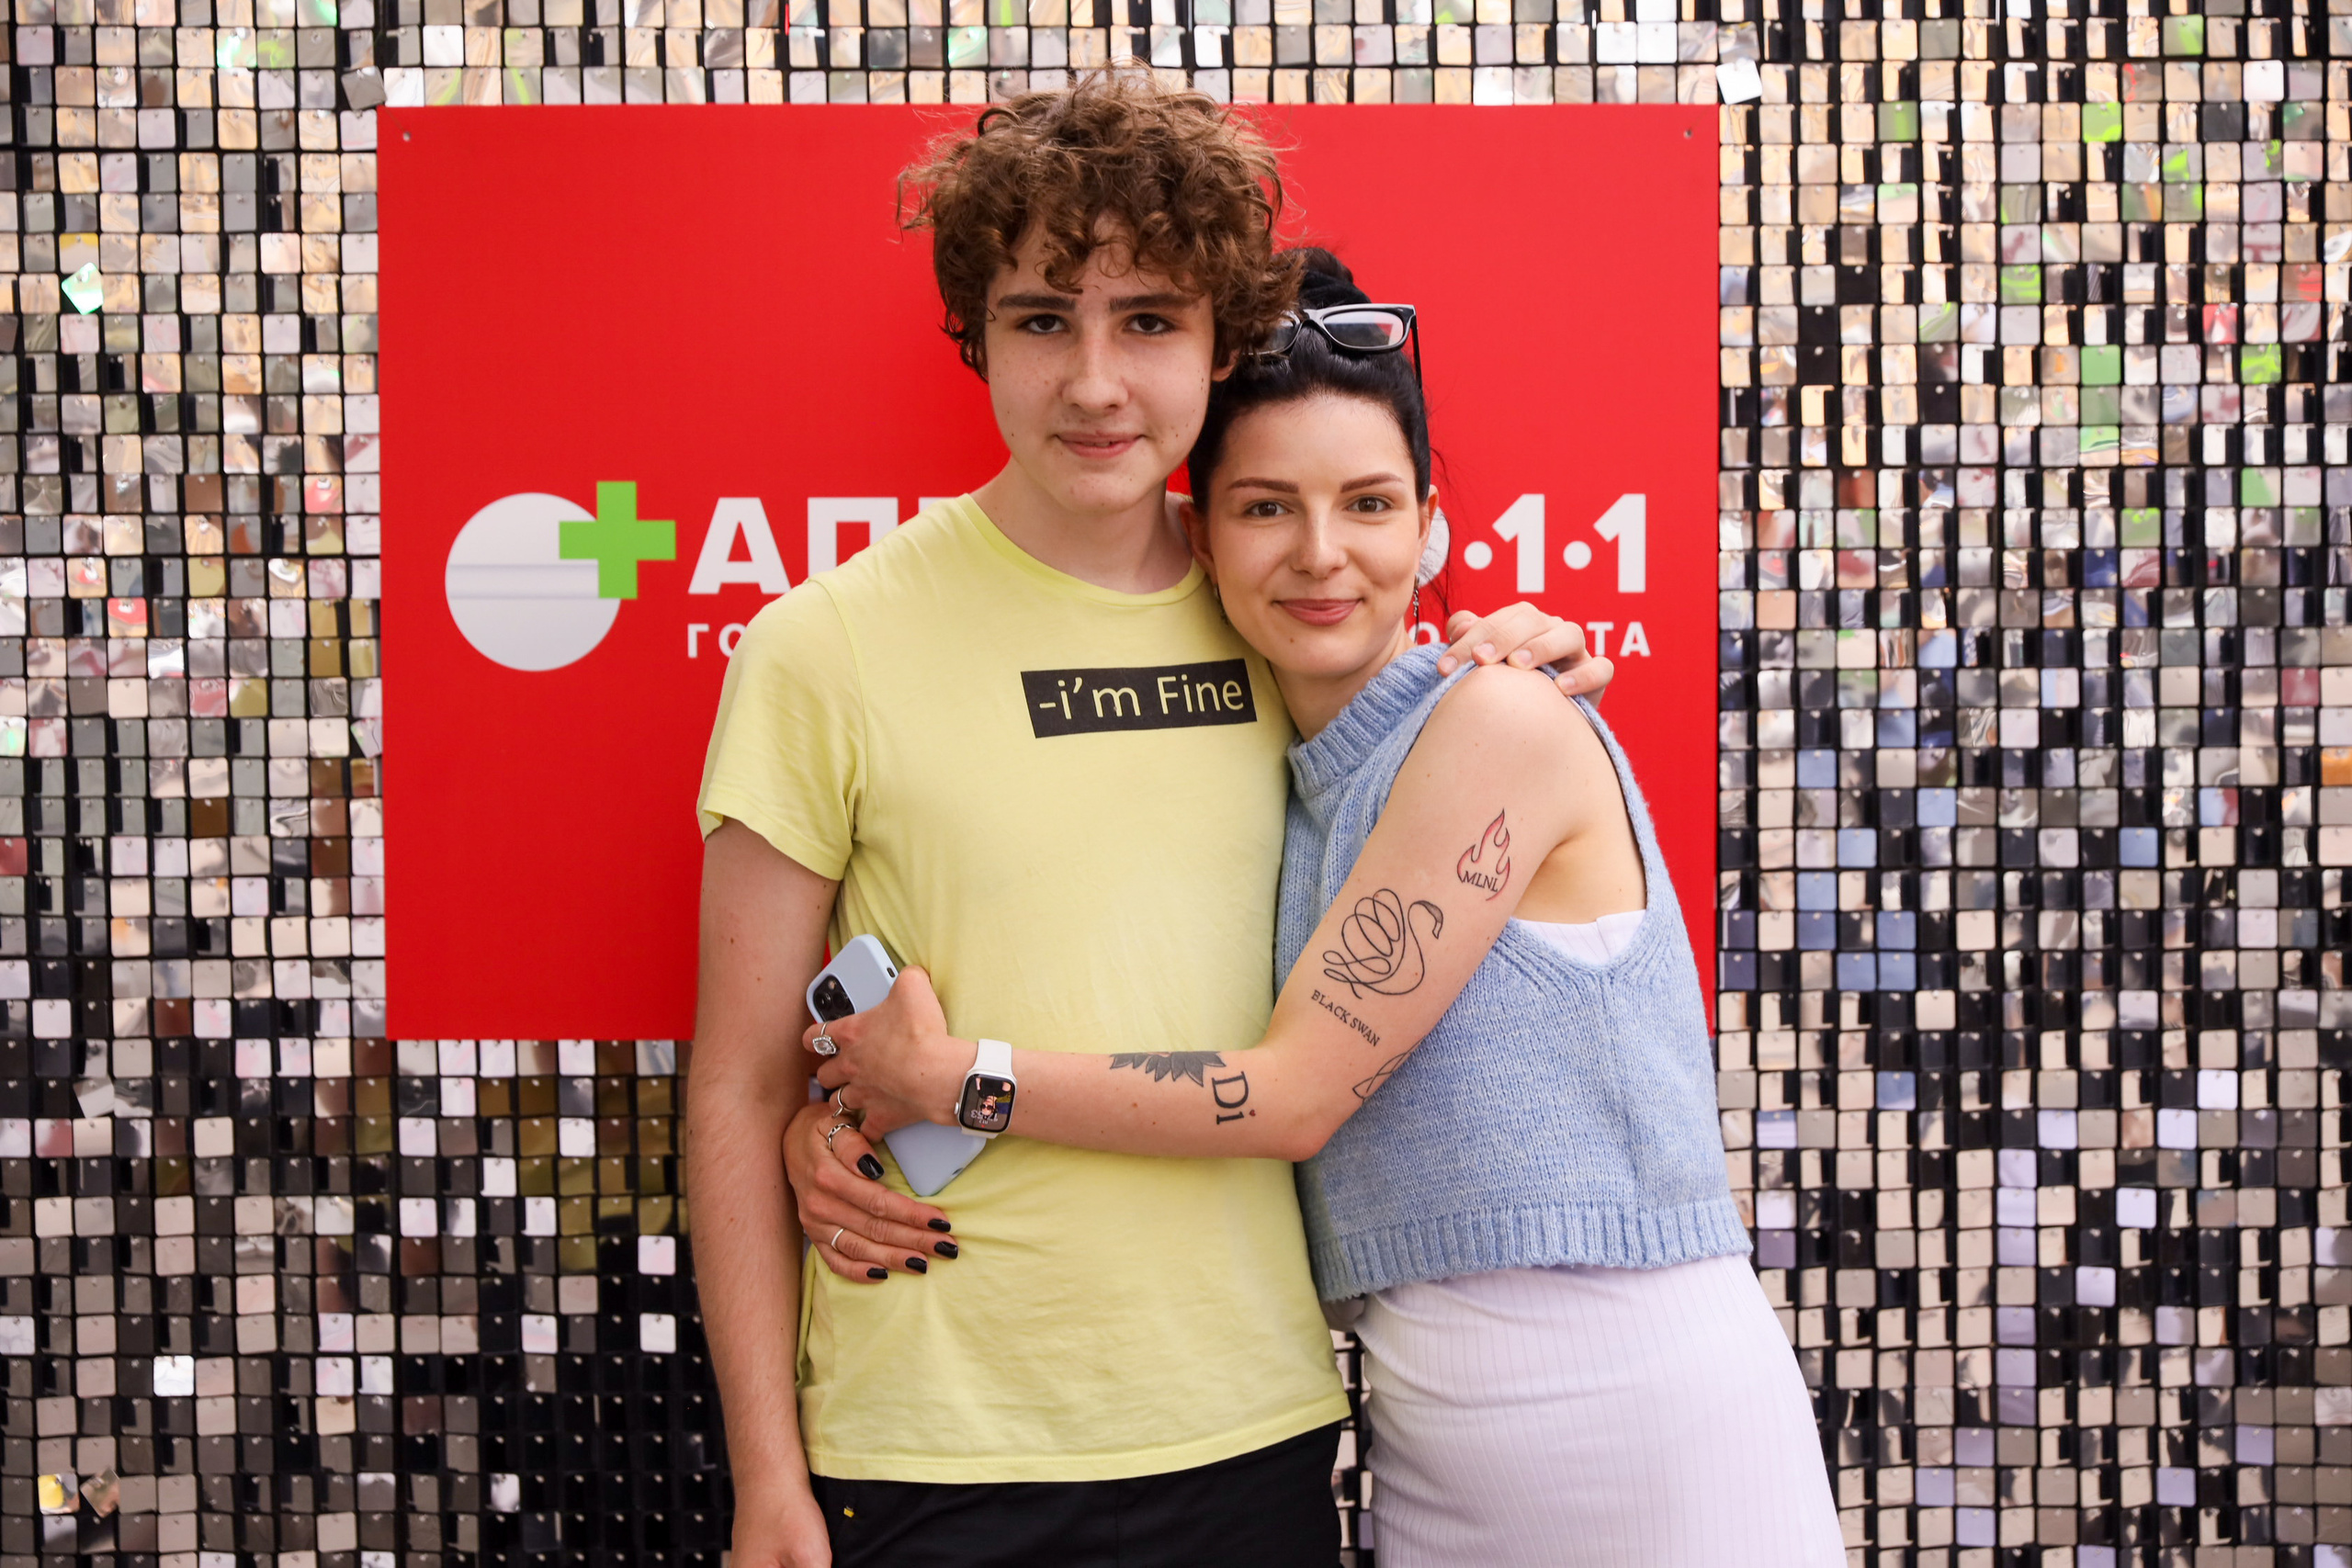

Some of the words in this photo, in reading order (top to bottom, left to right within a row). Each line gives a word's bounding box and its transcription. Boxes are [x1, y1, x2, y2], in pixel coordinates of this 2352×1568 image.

[687, 496, 960, 594] АП
[1157, 673, 1244, 715] Fine
[1311, 989, 1351, 1024] BLACK
[1350, 1017, 1380, 1047] SWAN
